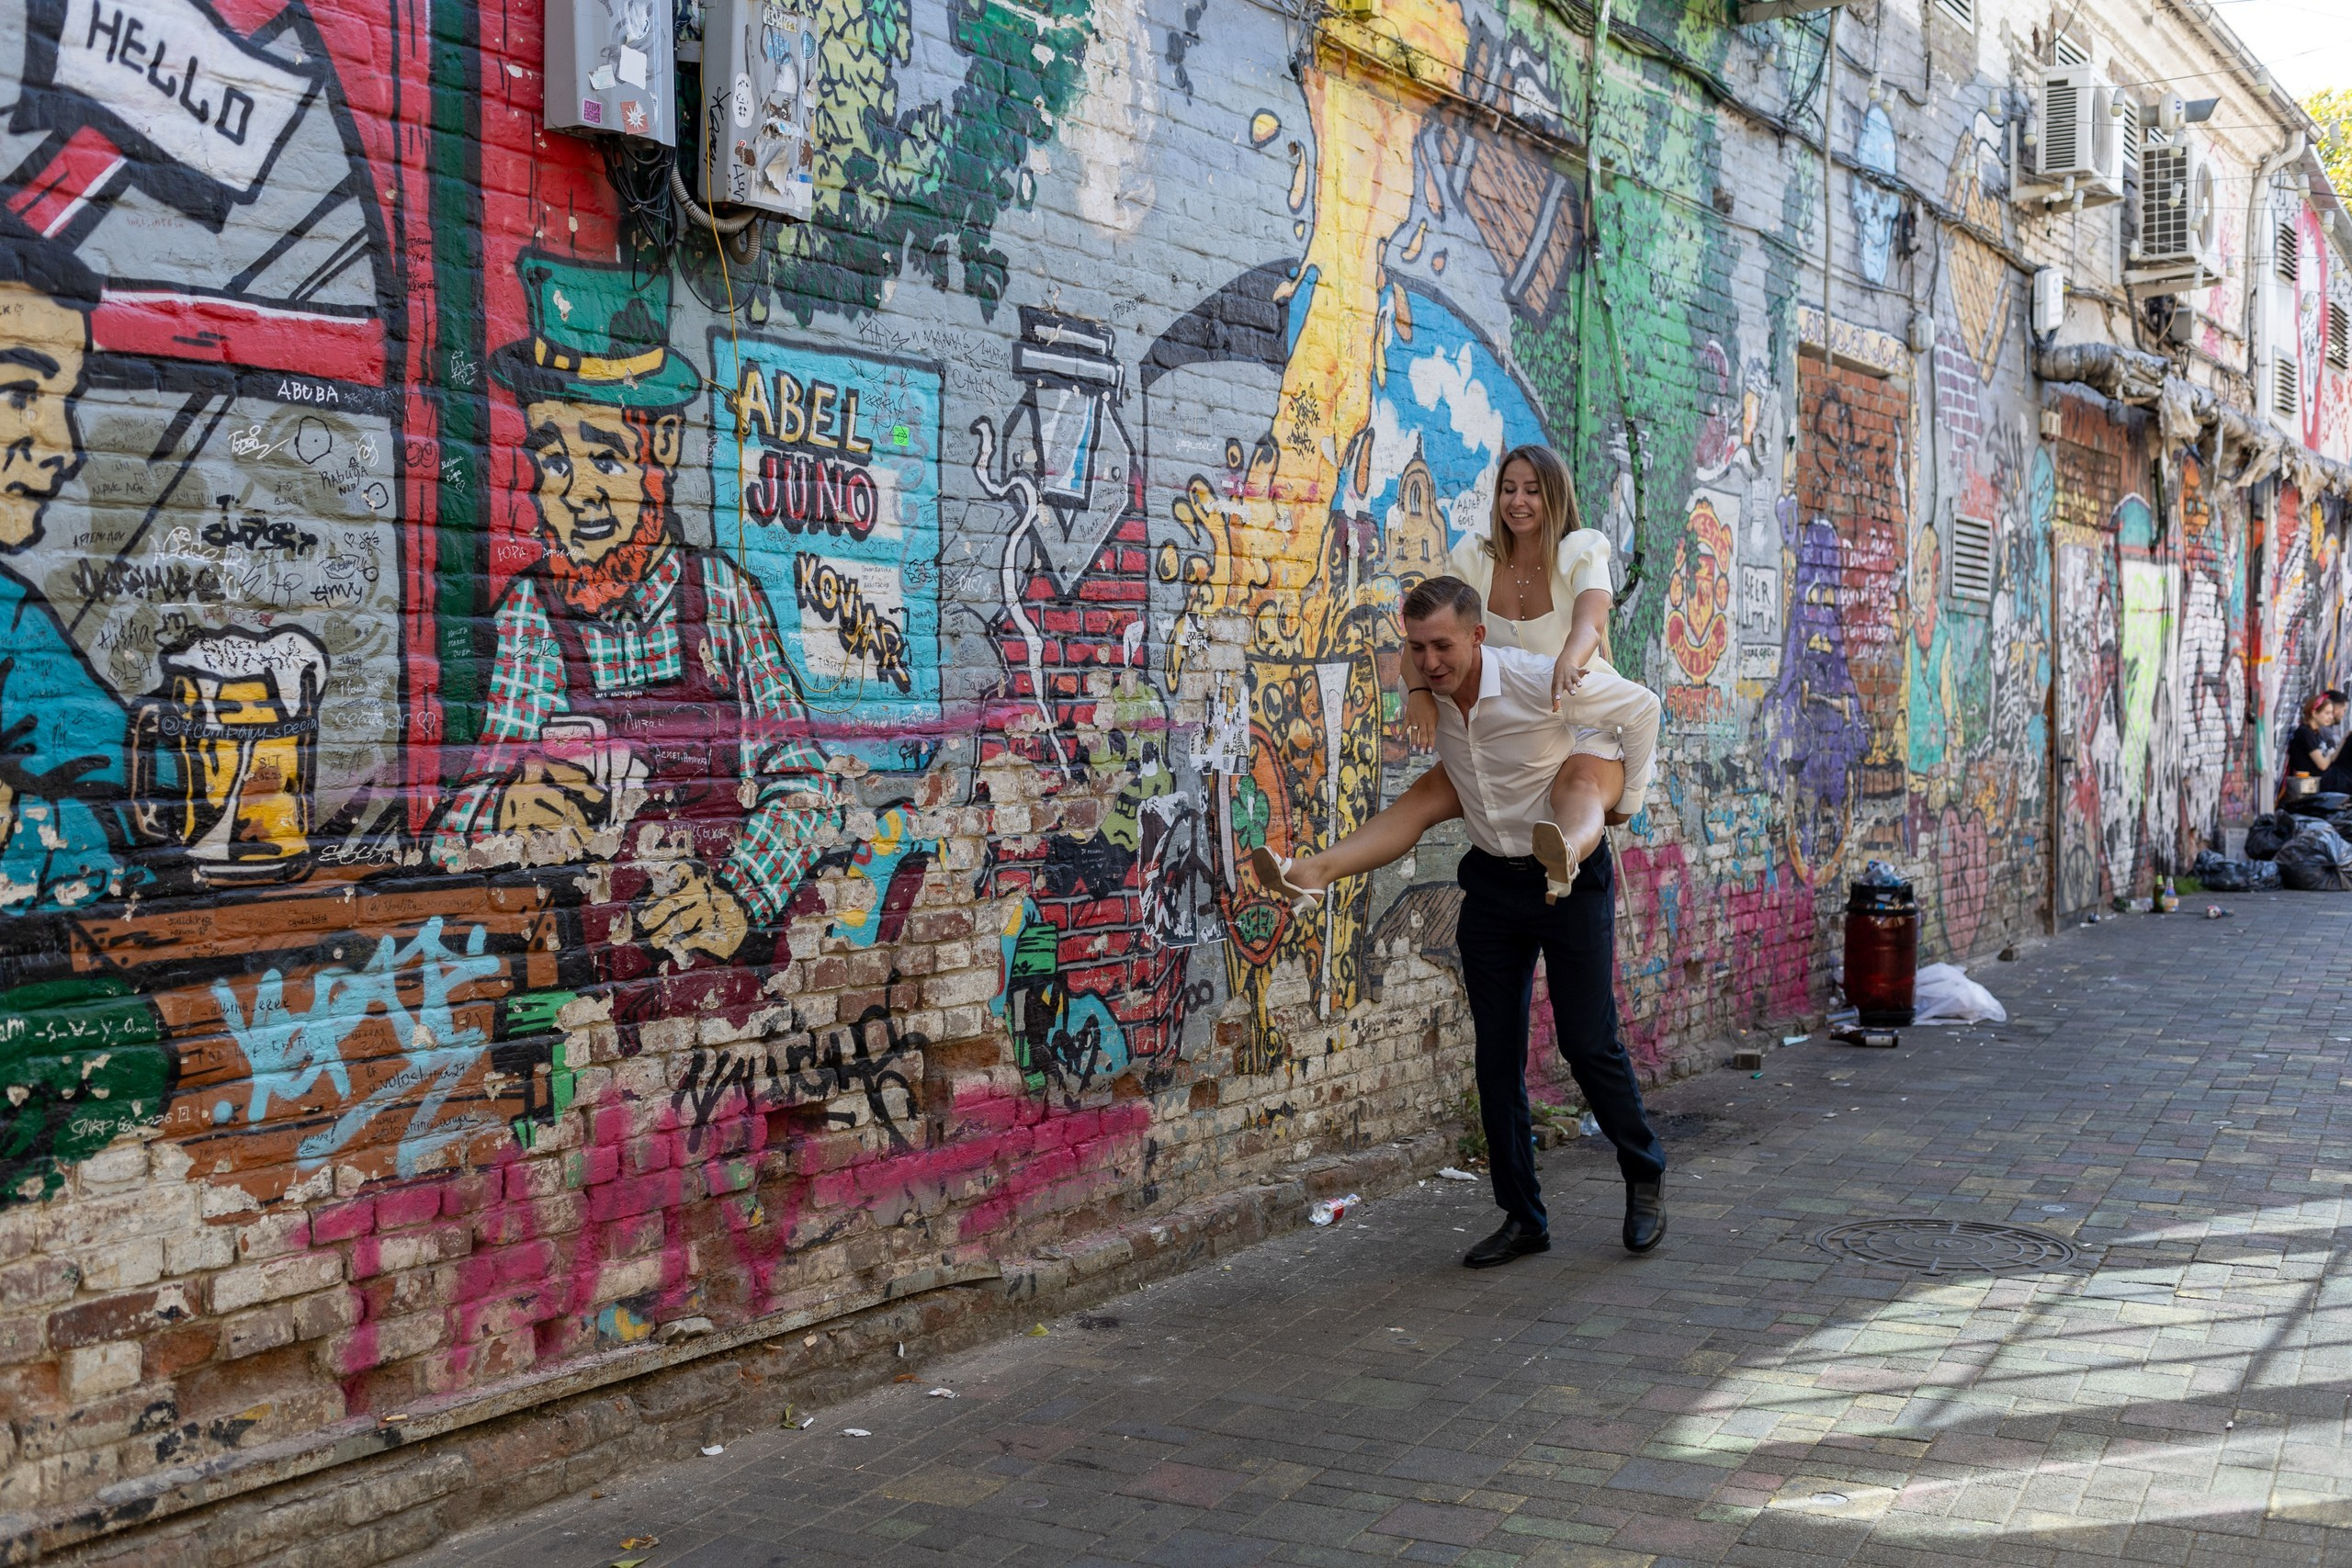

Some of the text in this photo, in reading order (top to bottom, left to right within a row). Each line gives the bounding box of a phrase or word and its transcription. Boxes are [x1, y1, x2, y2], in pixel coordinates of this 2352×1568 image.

[86, 7, 254, 145] HELLO
[735, 363, 874, 457] ABEL
[746, 453, 878, 541] JUNO
[1744, 571, 1770, 605] BEER
